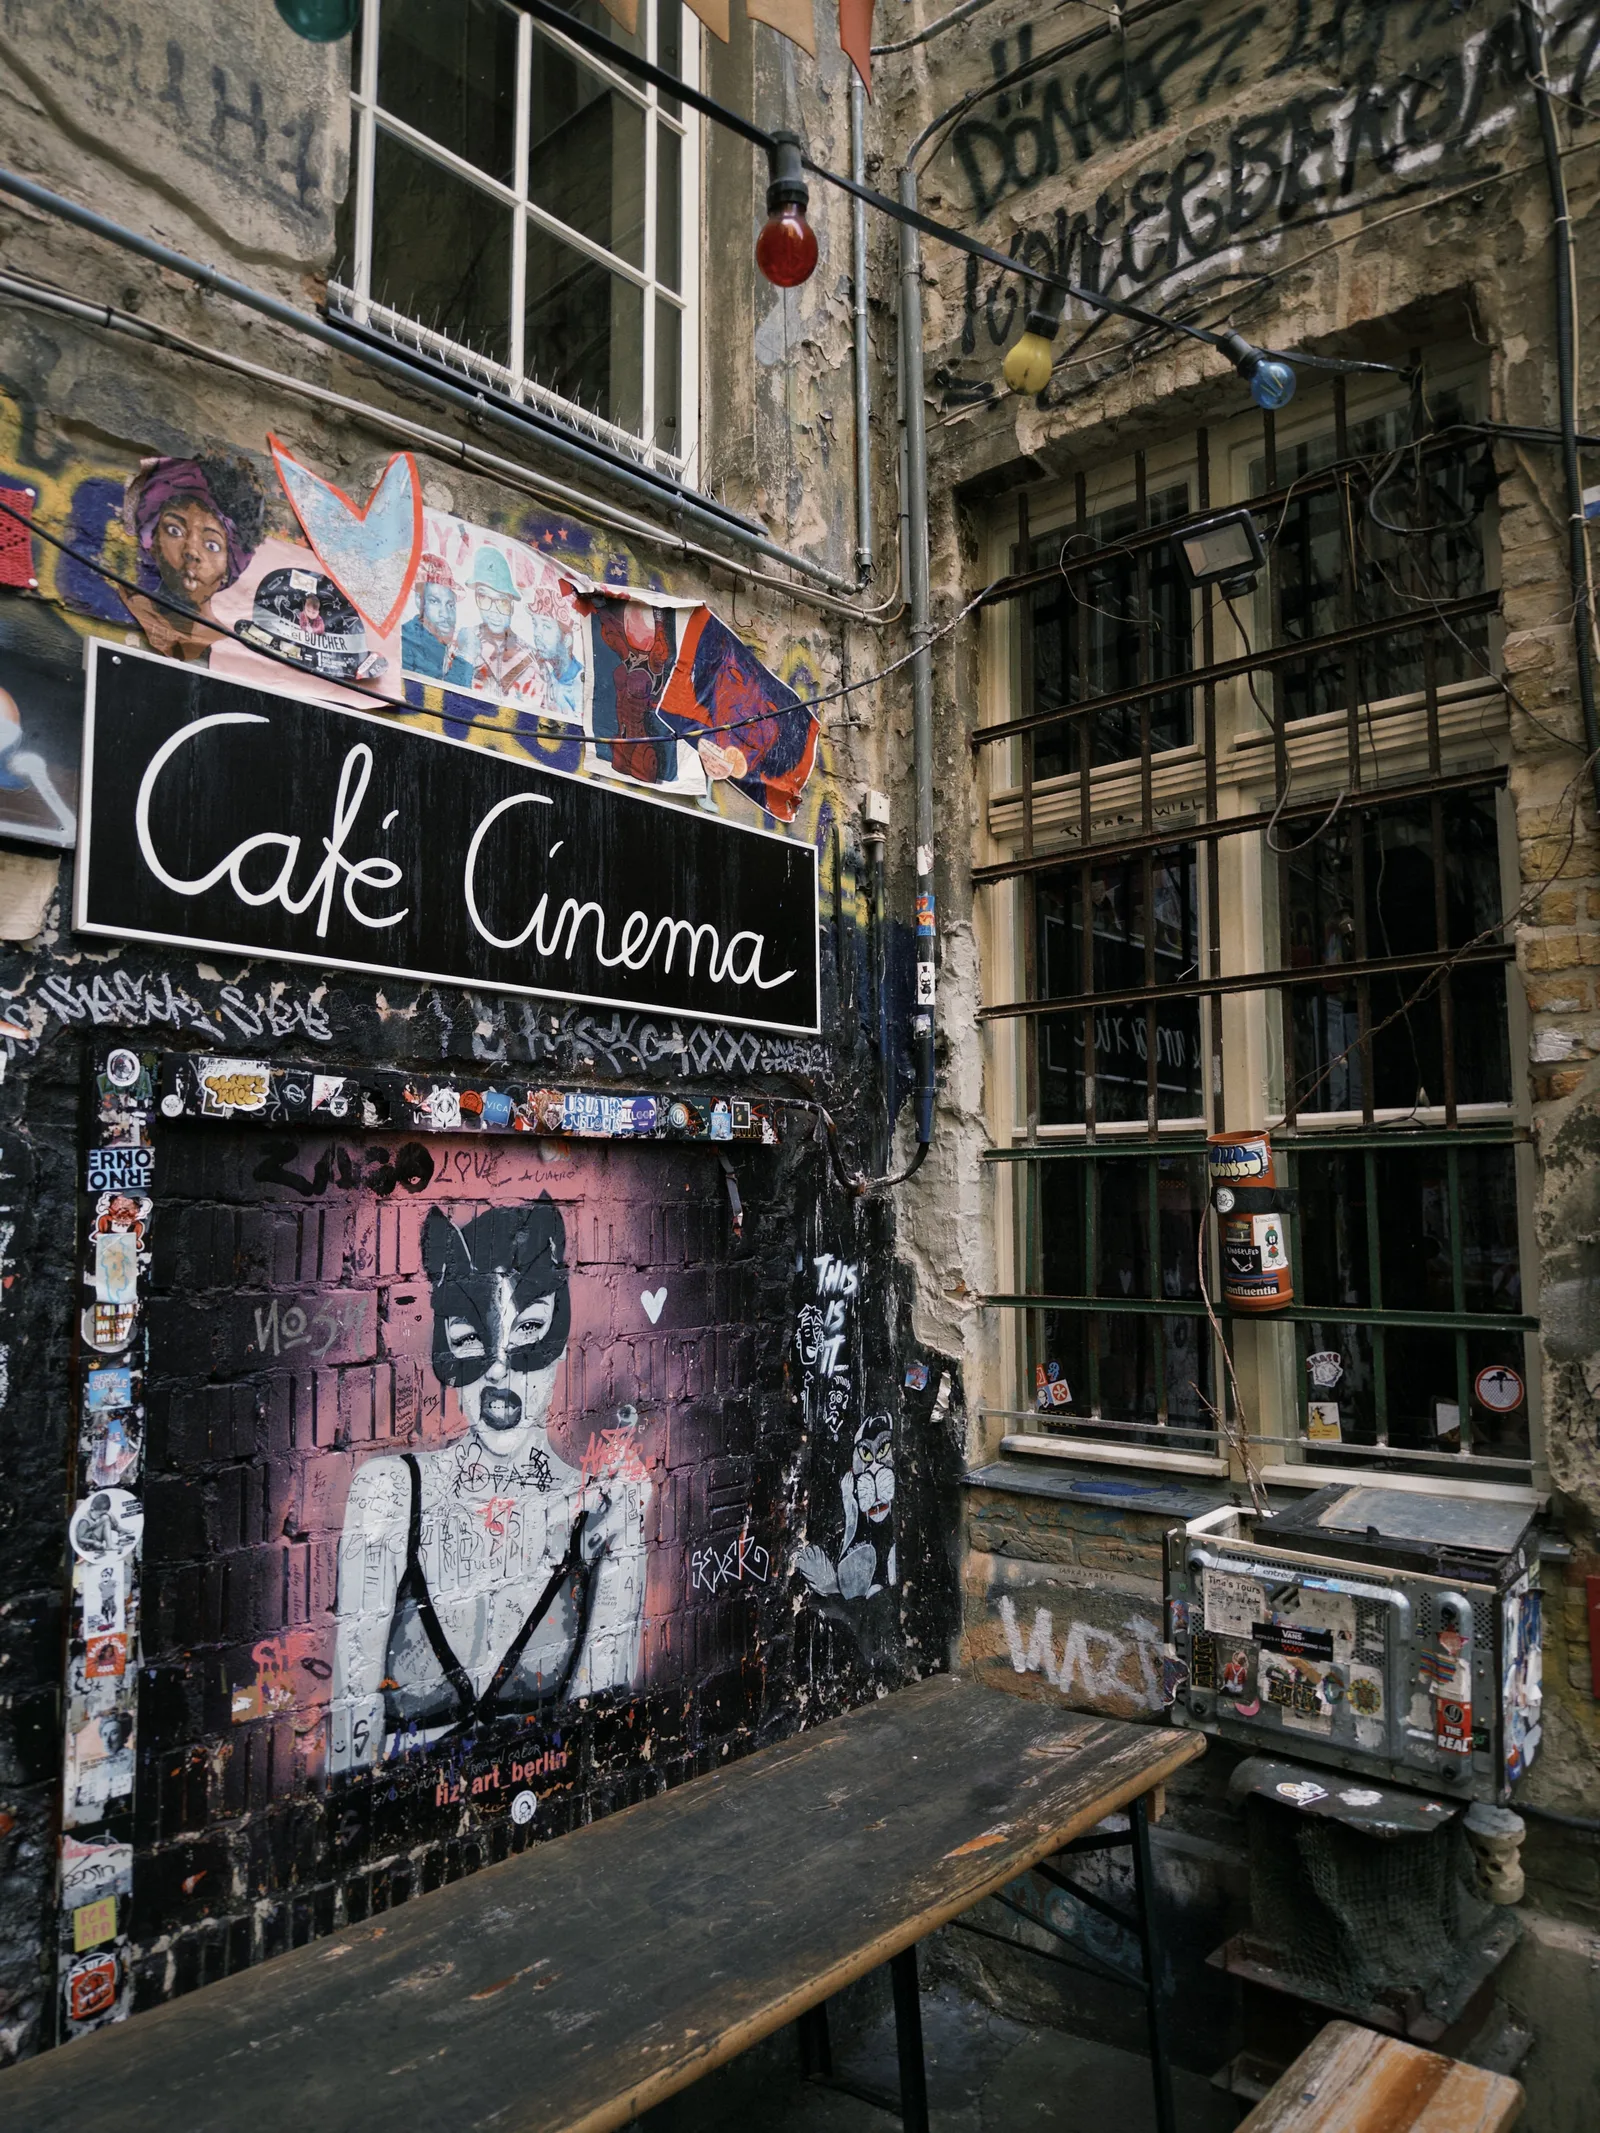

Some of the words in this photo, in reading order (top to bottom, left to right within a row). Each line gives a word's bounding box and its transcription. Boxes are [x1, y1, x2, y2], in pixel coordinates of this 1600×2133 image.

[304, 631, 348, 651] BUTCHER
[135, 711, 408, 938] Café
[464, 791, 797, 990] Cinema
[813, 1252, 859, 1295] THIS
[823, 1299, 846, 1331] IS
[819, 1333, 848, 1378] IT
[1236, 1581, 1261, 1596] Tours
[1281, 1628, 1303, 1641] VANS
[1444, 1724, 1463, 1737] THE
[1437, 1734, 1469, 1753] REAL
